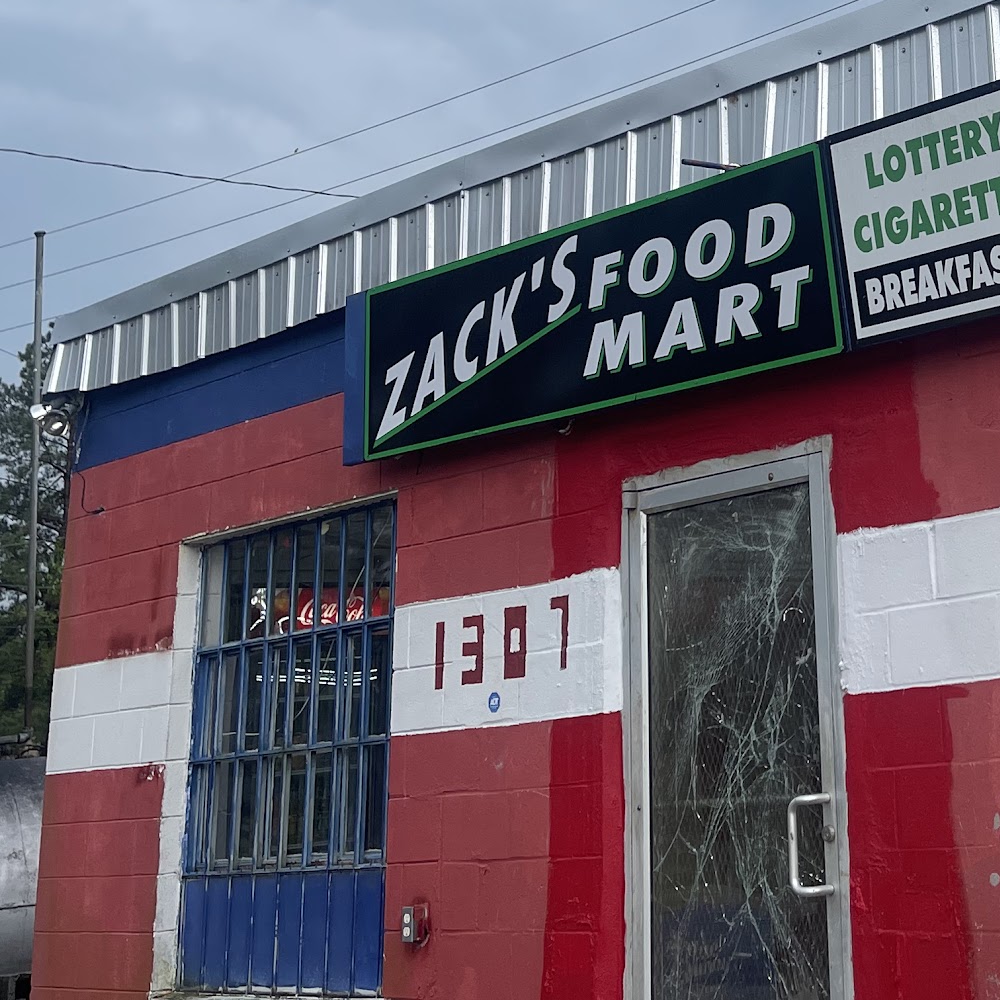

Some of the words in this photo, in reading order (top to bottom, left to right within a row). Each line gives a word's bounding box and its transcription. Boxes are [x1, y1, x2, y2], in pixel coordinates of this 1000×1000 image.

[375, 234, 579, 441] ZACK'S
[587, 202, 795, 311] FOOD
[582, 265, 813, 380] MART
[434, 594, 570, 690] 1307
